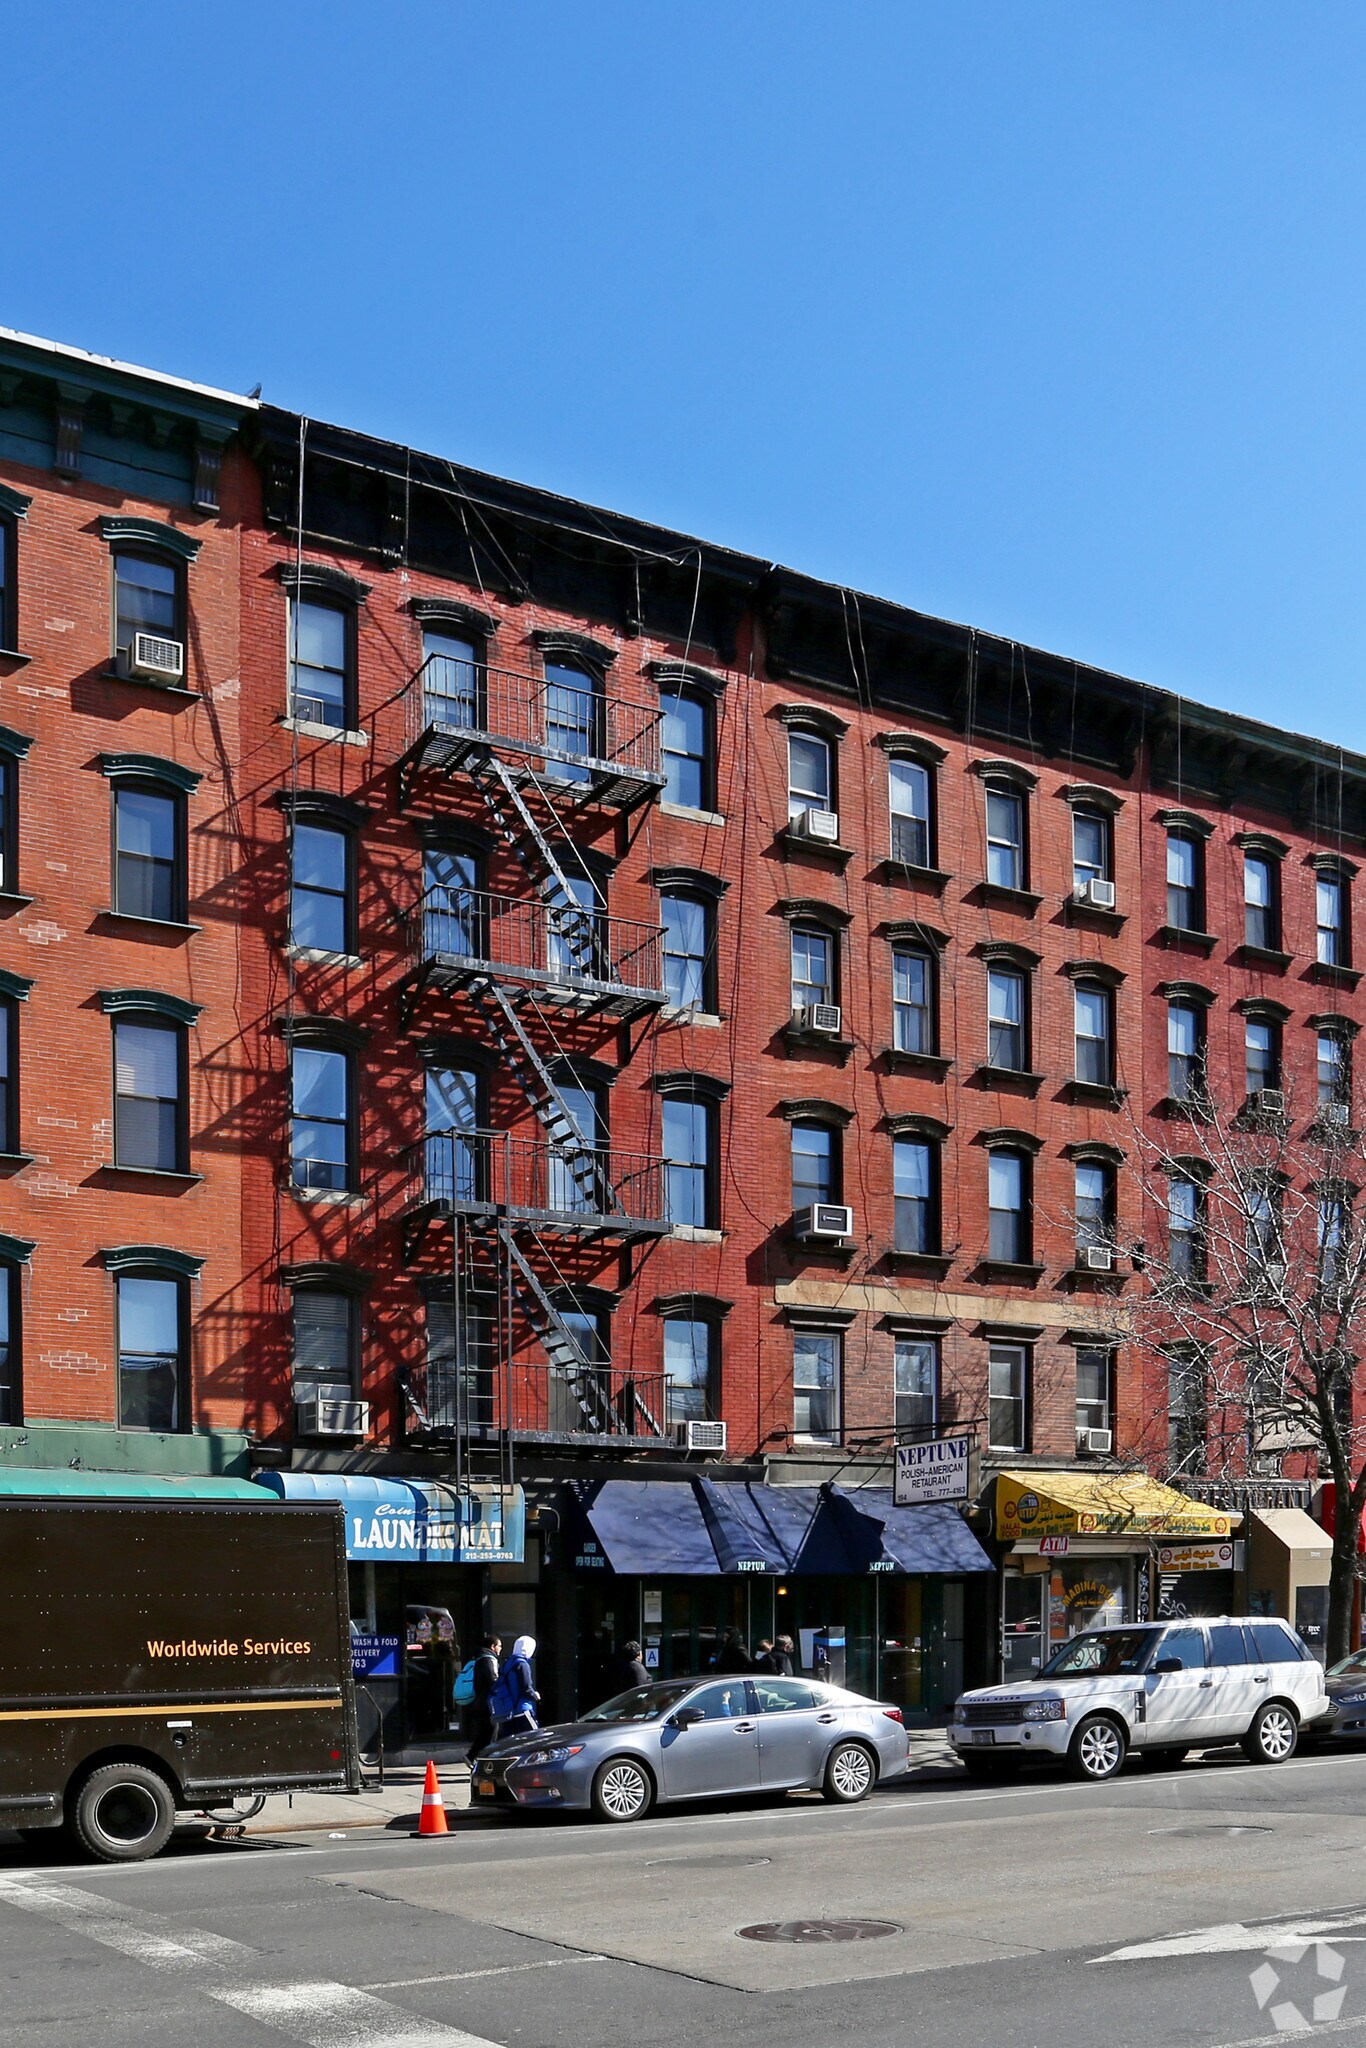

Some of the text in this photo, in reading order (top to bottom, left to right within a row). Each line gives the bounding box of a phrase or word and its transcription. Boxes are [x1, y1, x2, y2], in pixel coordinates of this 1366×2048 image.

[898, 1440, 968, 1467] NEPTUNE
[901, 1463, 963, 1479] POLISH-AMERICAN
[912, 1475, 951, 1488] RETAURANT
[923, 1490, 936, 1498] TEL:
[1001, 1522, 1021, 1530] HALAL
[353, 1517, 504, 1550] LAUNDROMAT
[1002, 1530, 1020, 1538] FOOD
[1042, 1536, 1066, 1551] ATM
[465, 1552, 514, 1560] 212-253-0763
[738, 1561, 766, 1571] NEPTUN
[869, 1562, 895, 1571] NEPTUN
[1062, 1580, 1097, 1606] MADINA
[147, 1637, 311, 1657] Worldwide Services
[353, 1638, 398, 1646] WASH & FOLD
[647, 1650, 657, 1662] A
